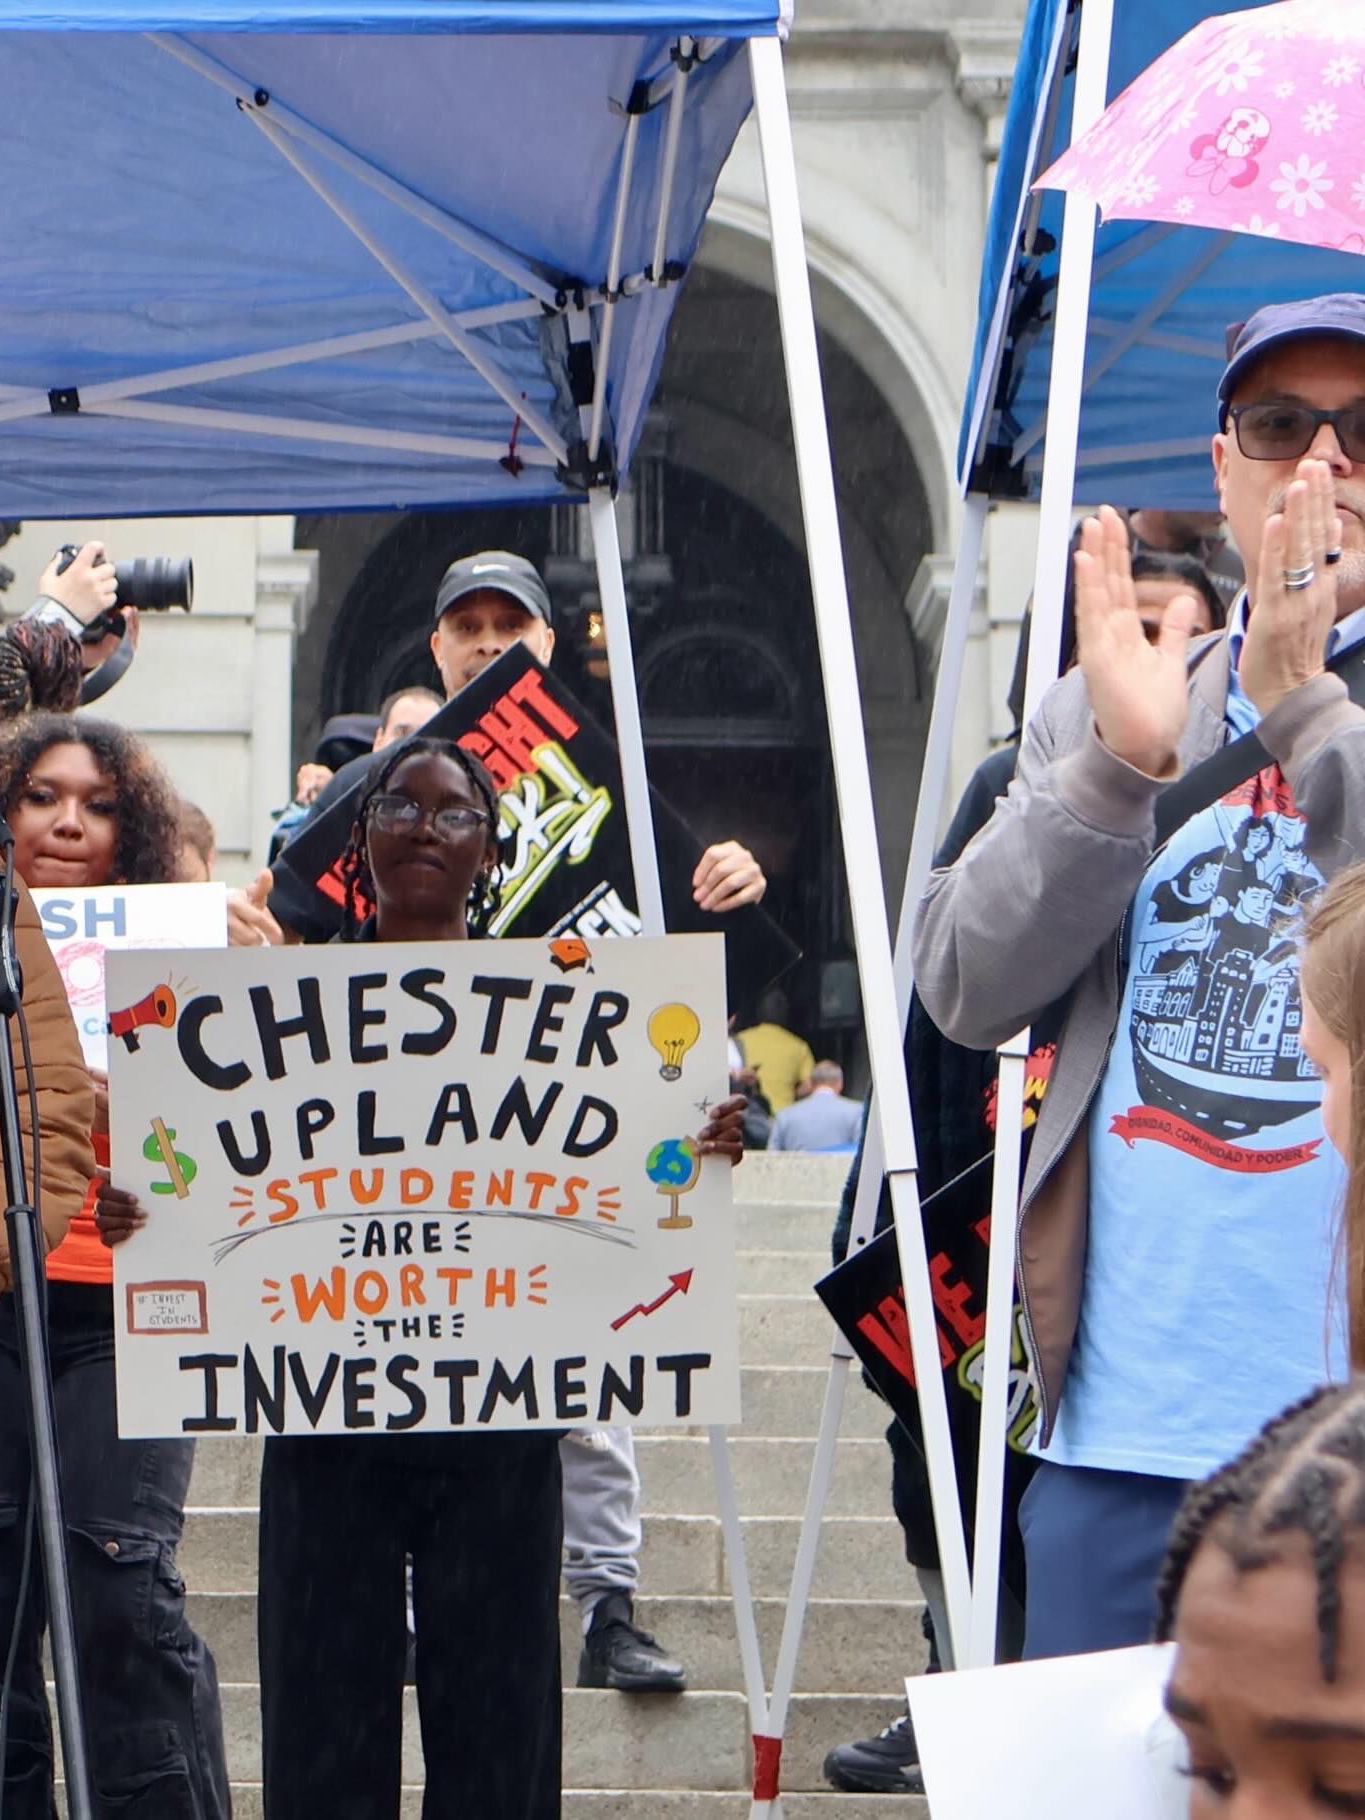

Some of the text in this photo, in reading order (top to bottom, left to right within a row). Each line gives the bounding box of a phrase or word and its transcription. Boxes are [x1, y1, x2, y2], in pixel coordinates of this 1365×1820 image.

[177, 967, 630, 1090] CHESTER
[216, 1076, 619, 1176] UPLAND
[1175, 1127, 1243, 1163] COMUNIDAD
[1257, 1149, 1303, 1166] PODER
[267, 1168, 589, 1223] STUDENTS
[362, 1220, 442, 1257] ARE
[156, 1306, 175, 1315] IN
[291, 1264, 516, 1323] WORTH
[373, 1316, 443, 1341] THE
[178, 1342, 711, 1434] INVESTMENT
